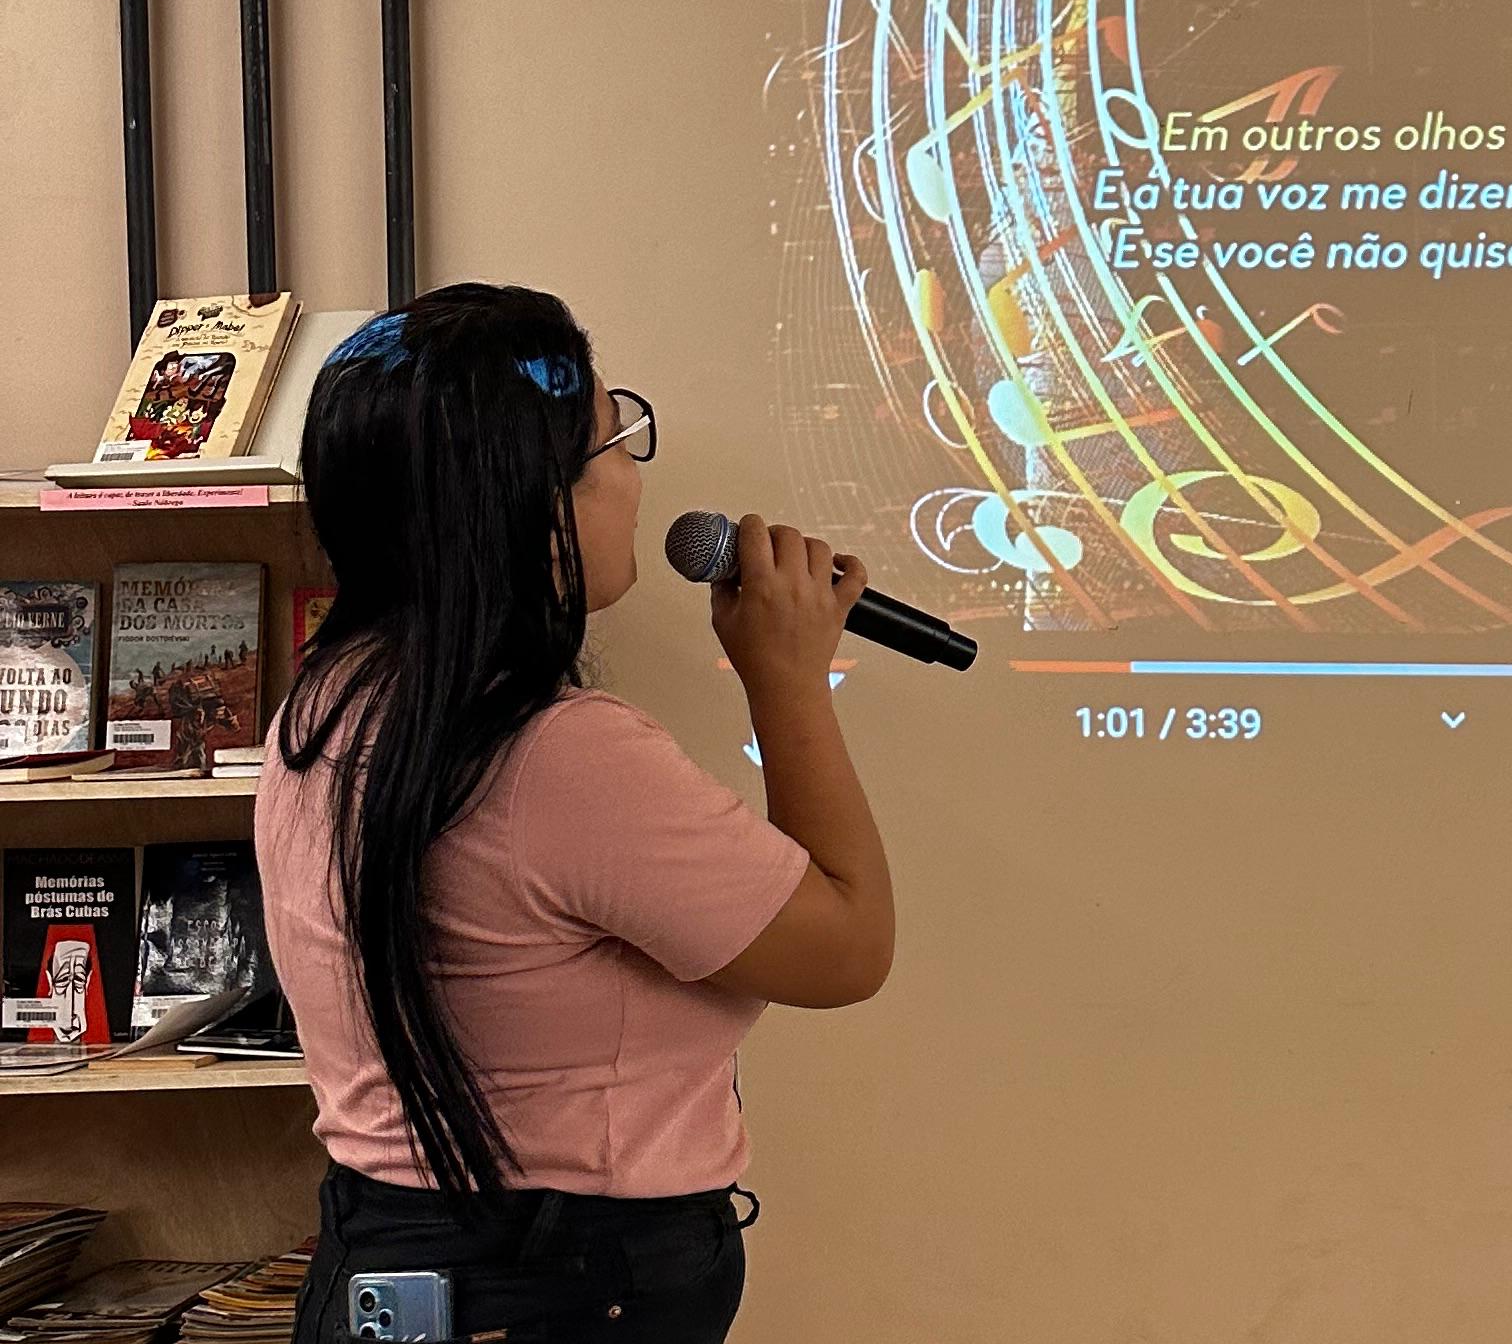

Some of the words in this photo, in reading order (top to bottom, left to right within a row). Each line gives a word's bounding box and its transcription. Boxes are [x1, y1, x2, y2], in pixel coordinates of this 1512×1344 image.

[1162, 111, 1228, 152] Em
[1242, 120, 1381, 152] outros
[1394, 110, 1506, 152] olhos
[1093, 169, 1125, 211] E
[1172, 177, 1246, 211] tua
[1256, 182, 1330, 211] voz
[1339, 182, 1408, 211] me
[1112, 227, 1145, 269] E
[1153, 241, 1200, 269] se
[1212, 231, 1316, 269] você
[1325, 231, 1409, 269] não
[29, 611, 66, 629] VERNE
[119, 614, 158, 631] DOS
[51, 667, 73, 686] AO
[33, 719, 71, 737] DIAS
[1075, 706, 1146, 739] 1:01
[1158, 706, 1177, 741] /
[1185, 706, 1262, 740] 3:39
[35, 874, 105, 889] Memórias
[25, 890, 95, 905] póstumas
[96, 889, 115, 904] de
[30, 904, 63, 919] Brás
[65, 904, 110, 918] Cubas
